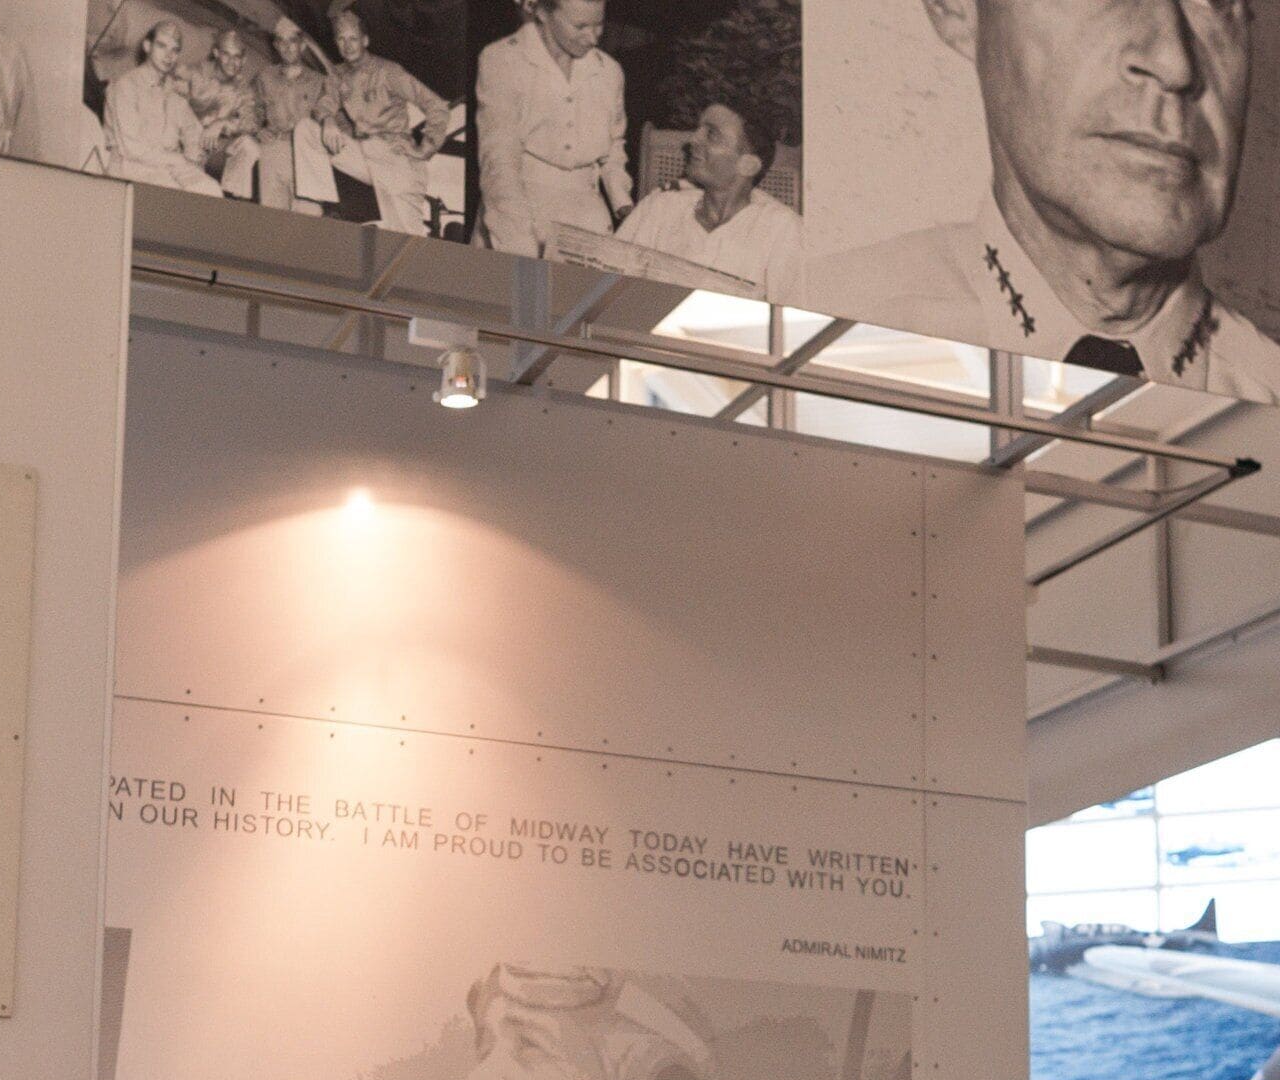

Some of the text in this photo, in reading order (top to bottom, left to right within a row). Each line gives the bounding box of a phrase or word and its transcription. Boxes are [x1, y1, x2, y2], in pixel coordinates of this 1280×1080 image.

[109, 774, 909, 877] ATED IN THE BATTLE OF MIDWAY TODAY HAVE WRITTEN
[138, 802, 198, 829] OUR
[212, 810, 334, 839] HISTORY.
[363, 827, 368, 844] I
[381, 828, 418, 849] AM
[433, 832, 523, 860] PROUD
[537, 843, 568, 864] TO
[580, 846, 611, 869] BE
[624, 851, 776, 885] ASSOCIATED
[786, 868, 844, 891] WITH
[855, 876, 910, 899] YOU.
[780, 937, 906, 964] ADMIRAL NIMITZ
